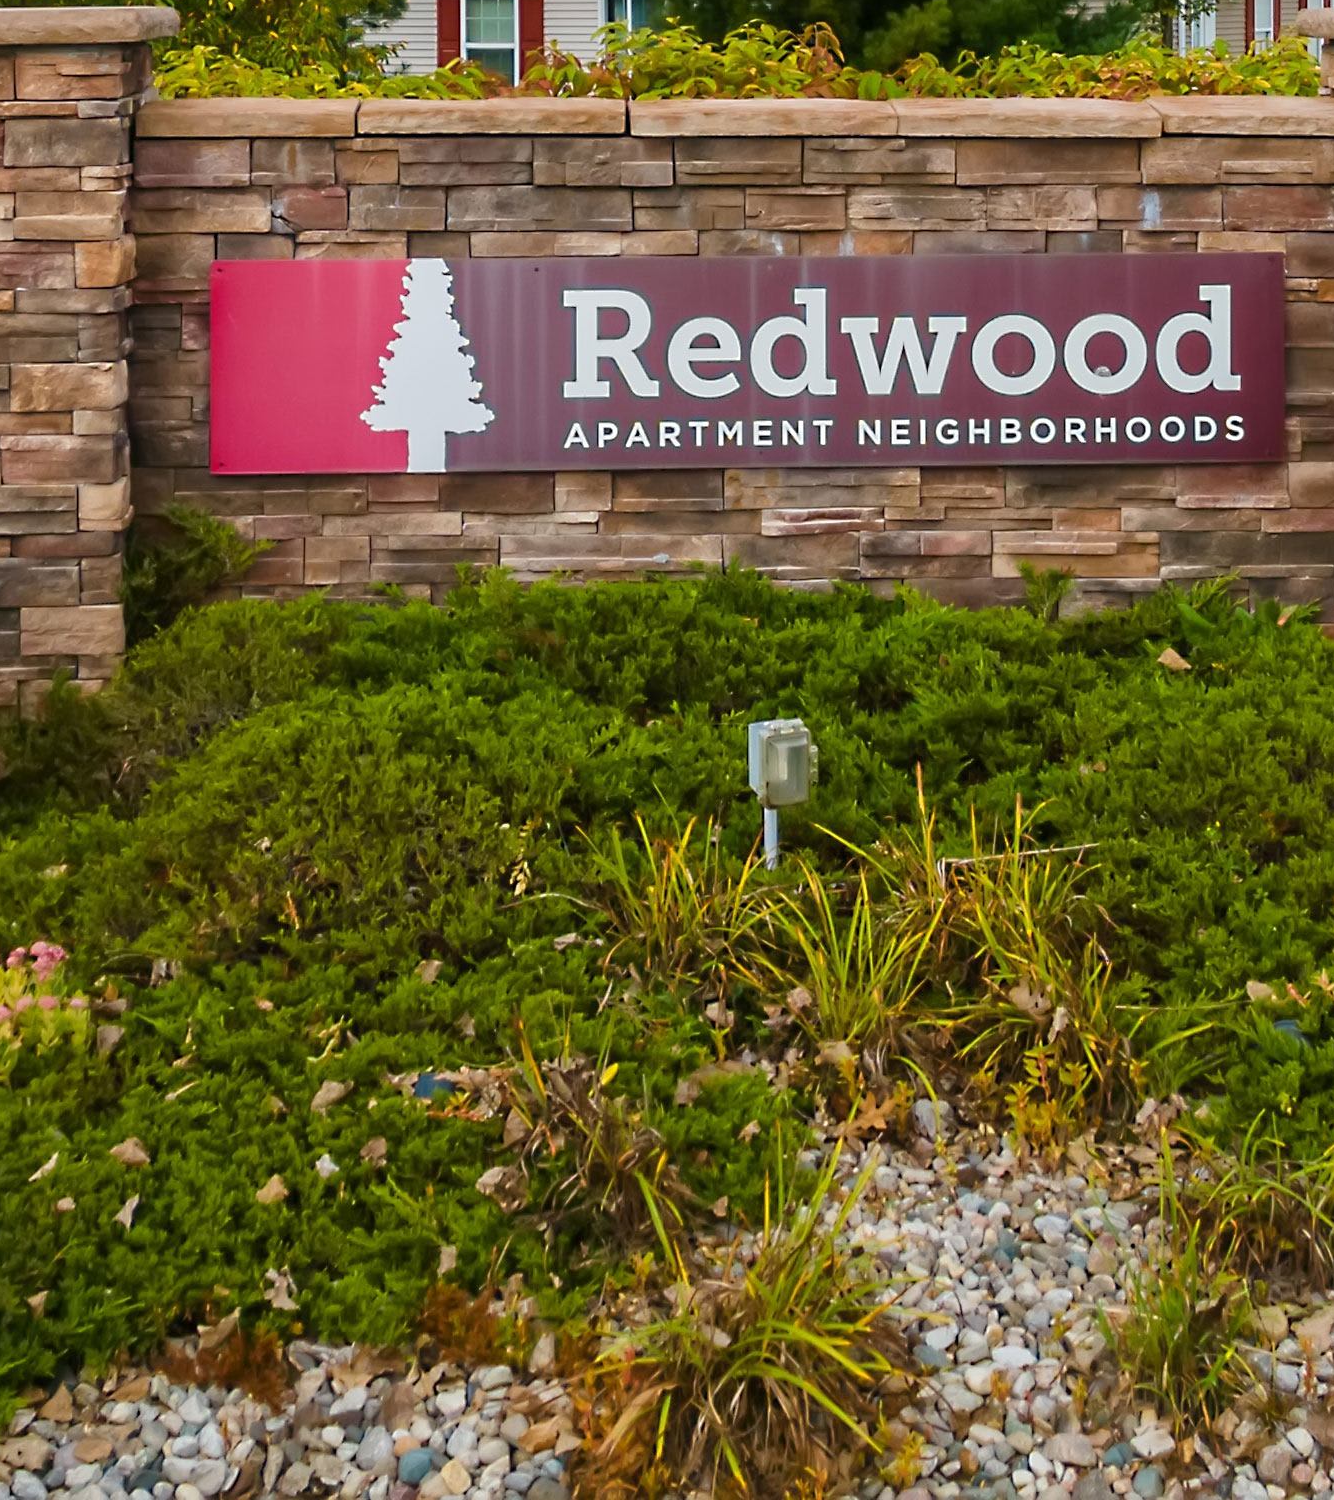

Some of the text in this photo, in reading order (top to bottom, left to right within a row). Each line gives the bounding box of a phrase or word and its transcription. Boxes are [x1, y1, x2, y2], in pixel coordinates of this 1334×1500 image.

[561, 284, 1243, 399] Redwood
[562, 414, 1246, 450] APARTMENT NEIGHBORHOODS
